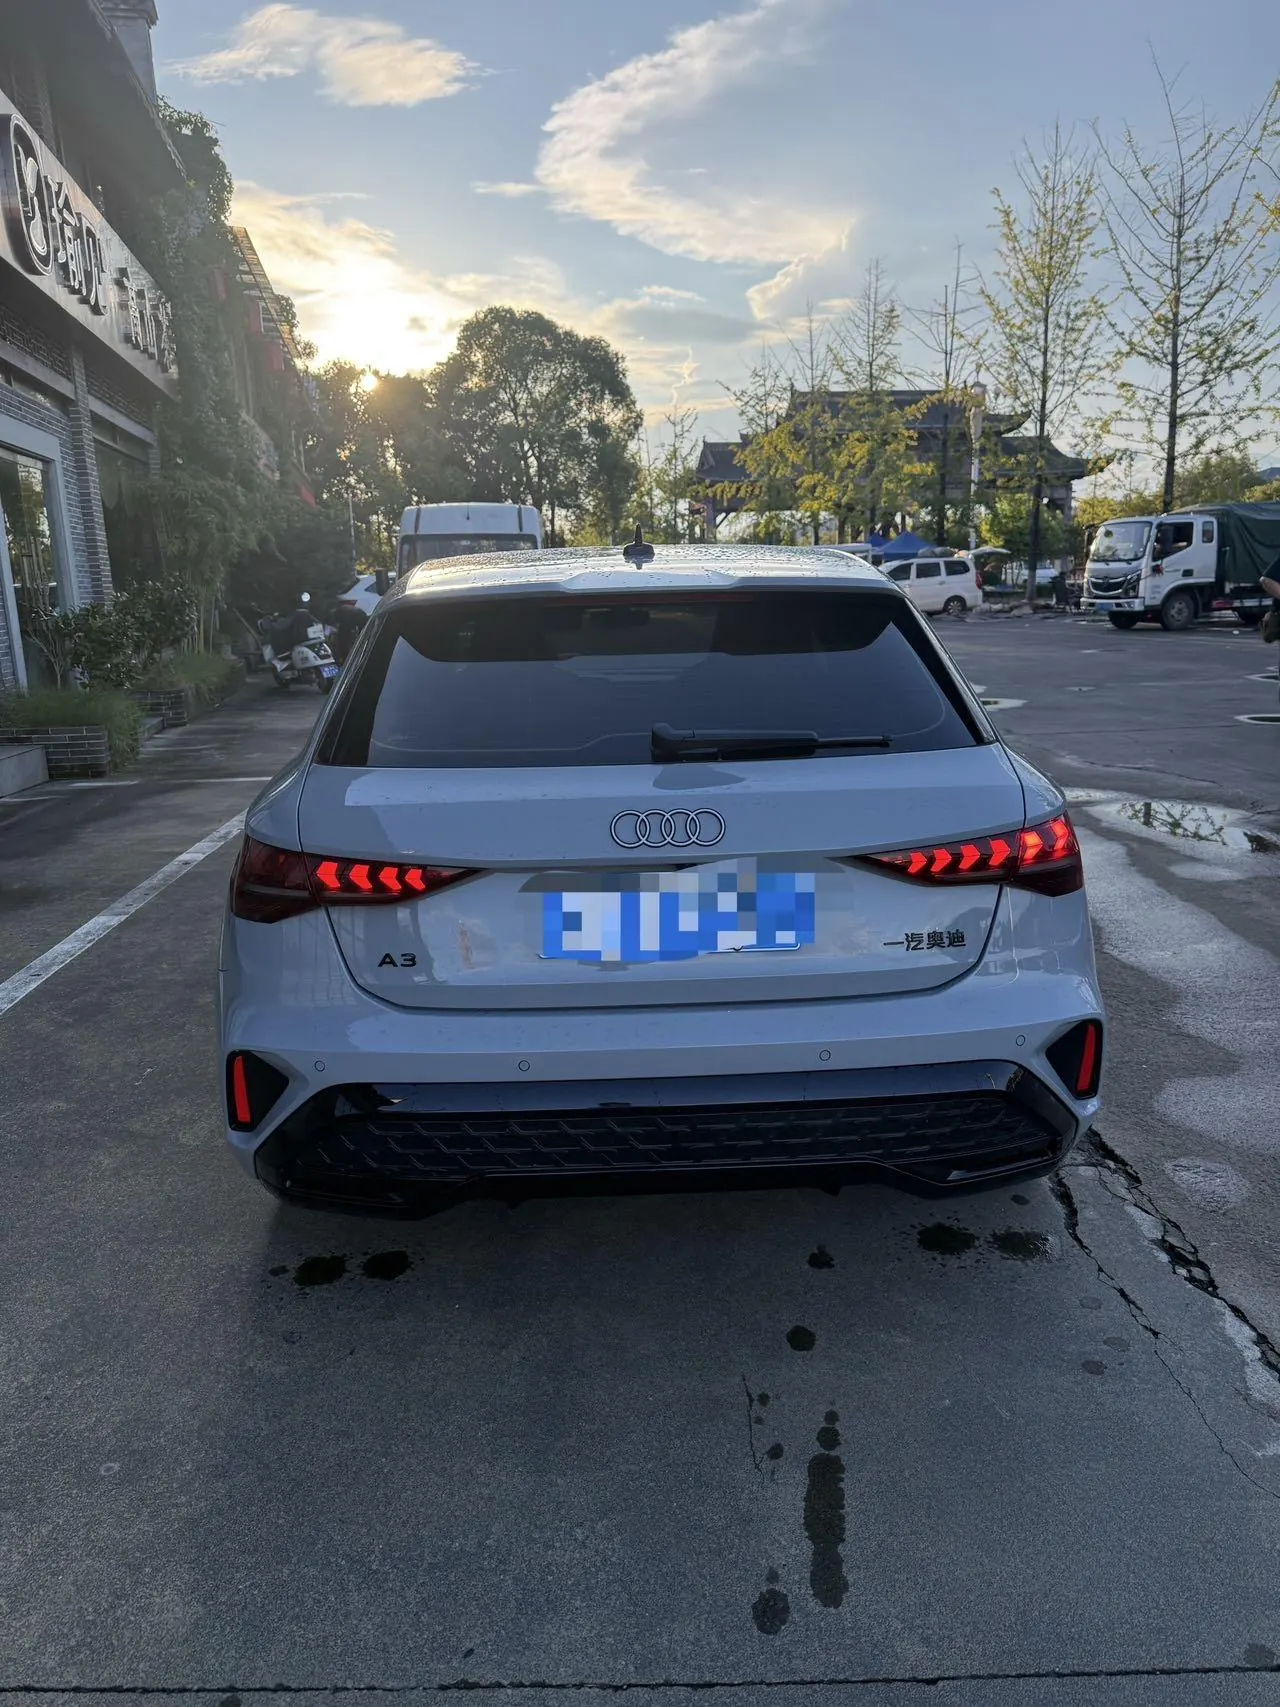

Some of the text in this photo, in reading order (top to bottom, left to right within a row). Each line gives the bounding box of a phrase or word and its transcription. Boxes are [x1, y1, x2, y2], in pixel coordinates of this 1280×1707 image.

[882, 928, 967, 952] 一汽奥迪
[377, 952, 417, 968] A3
